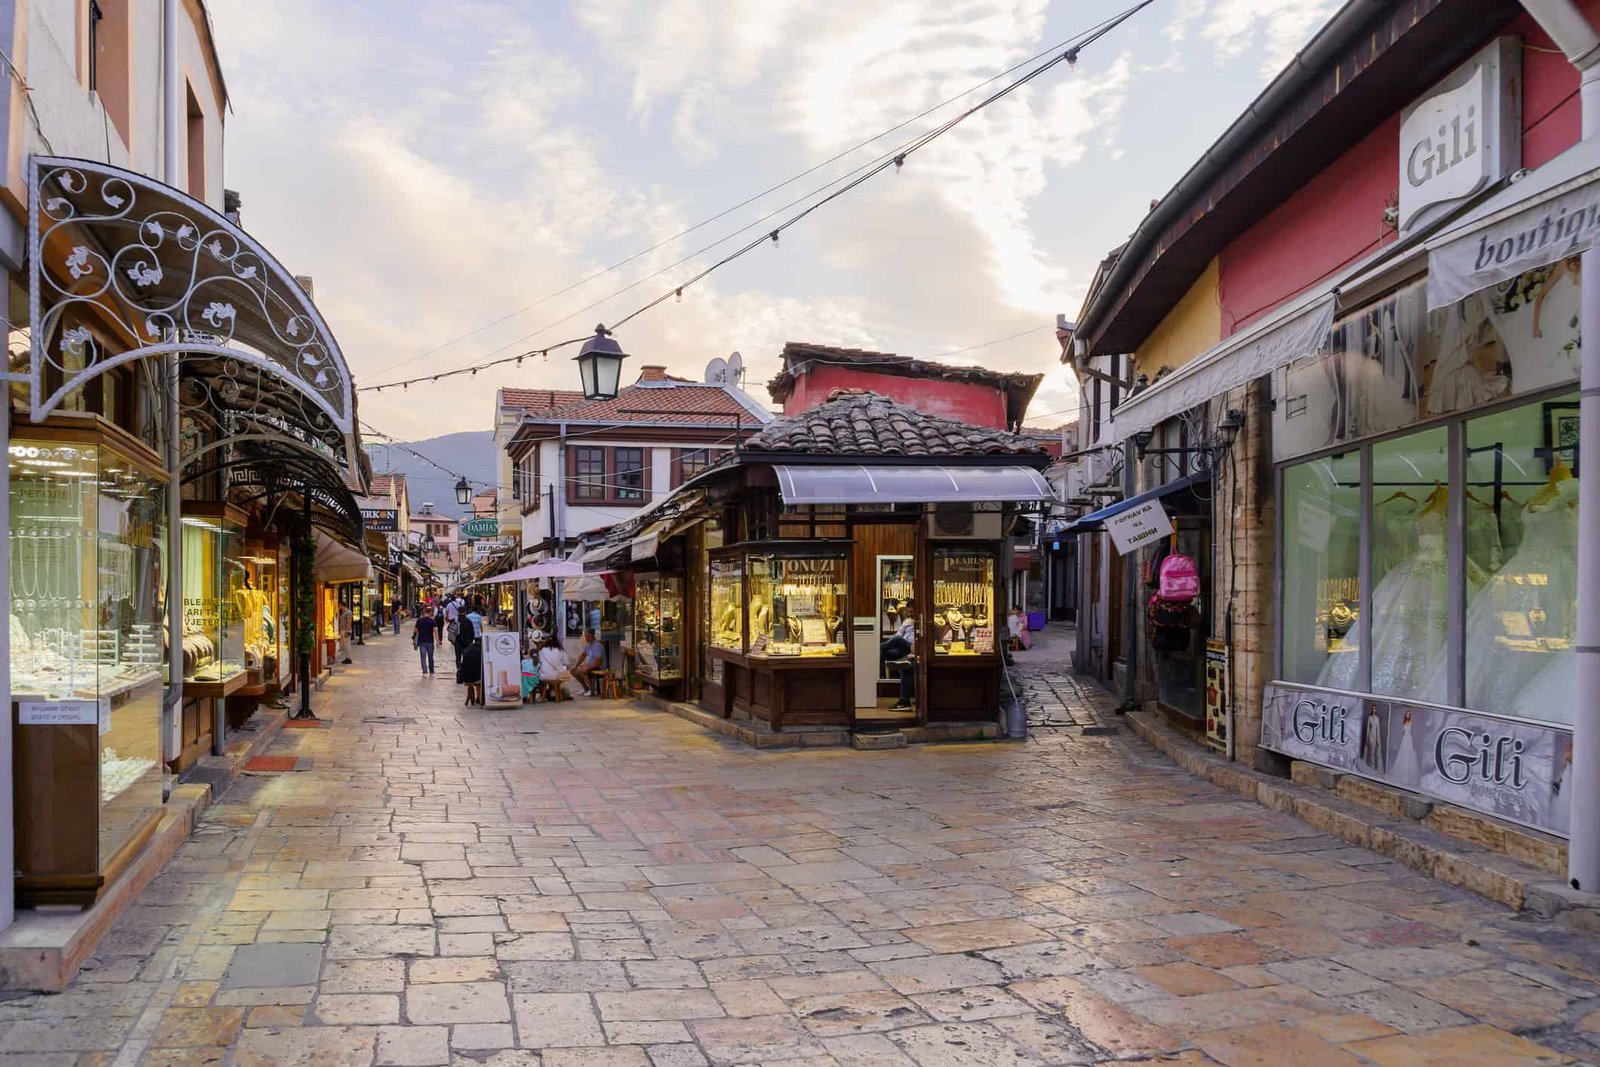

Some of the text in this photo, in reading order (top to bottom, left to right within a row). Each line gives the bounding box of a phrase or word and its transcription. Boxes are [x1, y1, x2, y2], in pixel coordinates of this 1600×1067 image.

[1407, 105, 1477, 187] Gili
[780, 559, 835, 579] JONUZI
[944, 557, 984, 571] PEARLS
[1292, 699, 1348, 746] Gili
[1434, 726, 1528, 791] Gili
